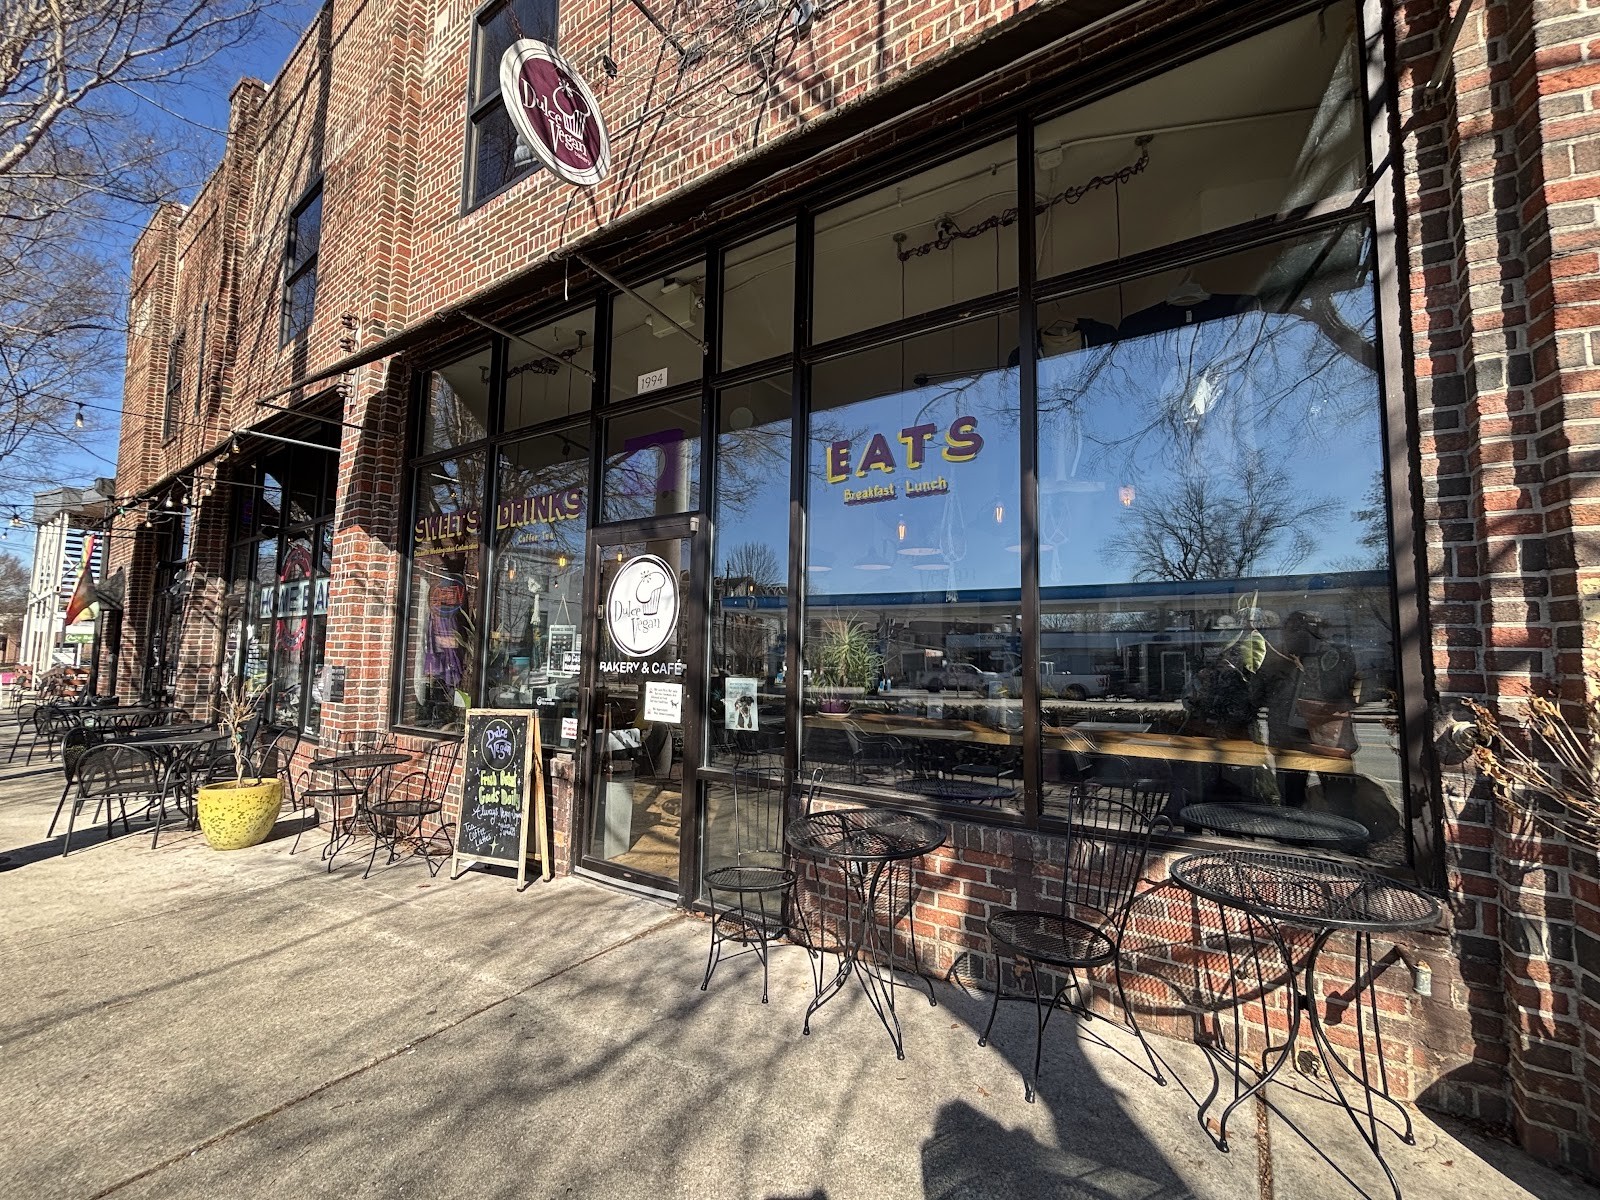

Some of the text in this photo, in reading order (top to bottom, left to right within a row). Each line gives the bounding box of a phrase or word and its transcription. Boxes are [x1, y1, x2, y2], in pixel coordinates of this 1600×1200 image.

[520, 78, 562, 126] Dulce
[548, 119, 588, 157] Vegan
[641, 373, 663, 390] 1994
[826, 415, 985, 485] EATS
[843, 476, 948, 504] Breakfast Lunch
[496, 487, 583, 531] DRINKS
[414, 505, 482, 543] SWEETS
[518, 531, 555, 544] Coffee Tea
[614, 600, 641, 622] Dulce
[631, 617, 660, 645] Vegan
[572, 652, 580, 663] Cas
[600, 658, 683, 675] BAKERY & CAFÉ
[486, 726, 508, 747] Dulce
[488, 740, 512, 759] Vegan
[501, 788, 520, 811] Daily
